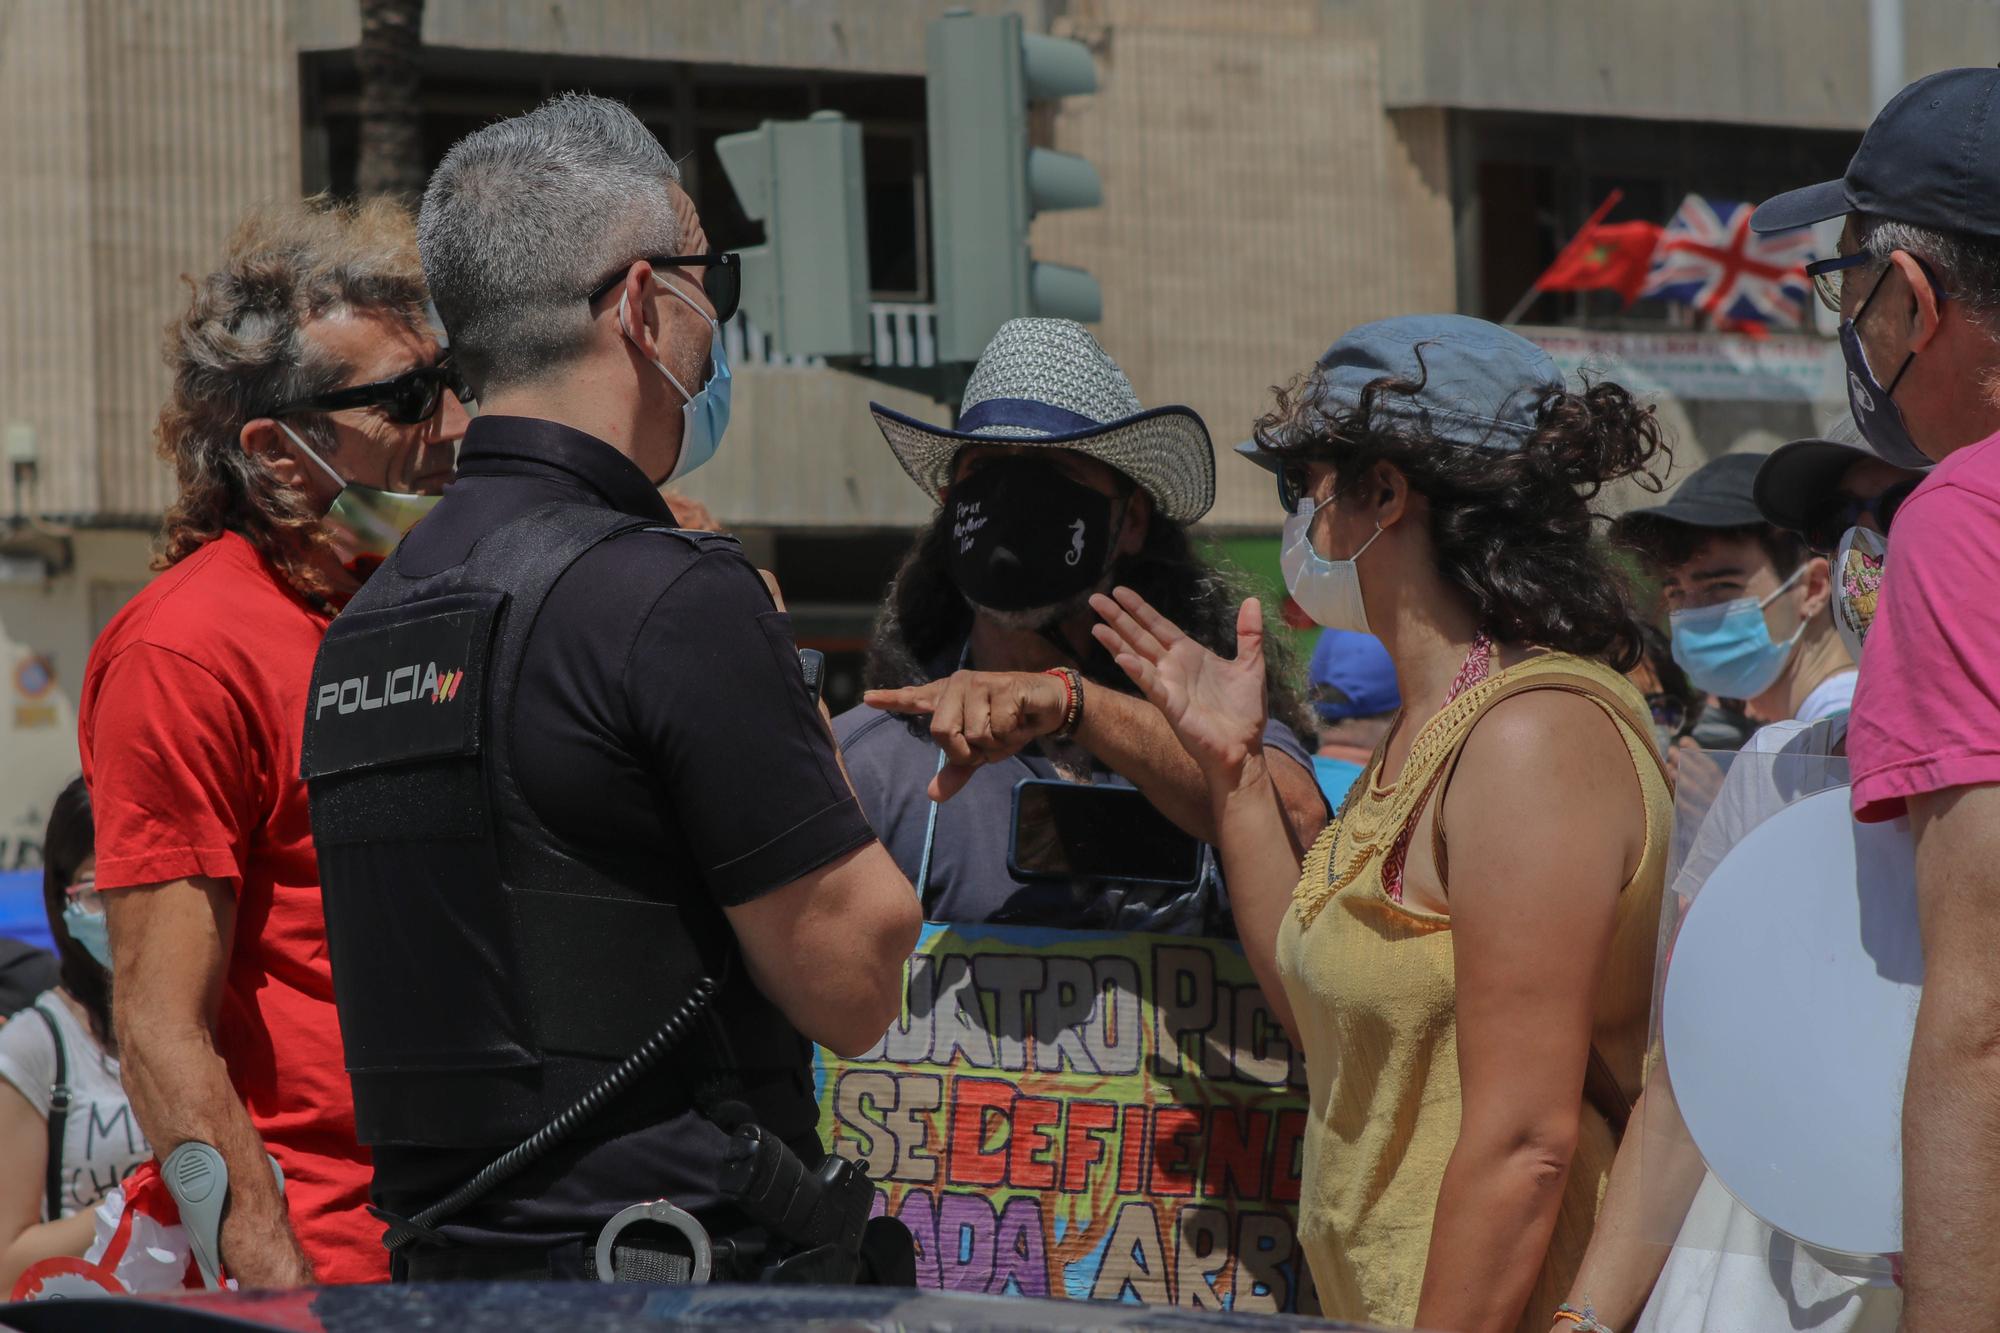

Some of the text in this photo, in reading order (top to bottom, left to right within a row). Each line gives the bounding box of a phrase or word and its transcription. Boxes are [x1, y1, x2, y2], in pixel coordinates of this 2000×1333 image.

[315, 661, 440, 721] POLICIA
[840, 943, 1307, 1088] UATRO PIC
[833, 1069, 944, 1184] SE
[870, 1188, 1320, 1316] ADA ARB
